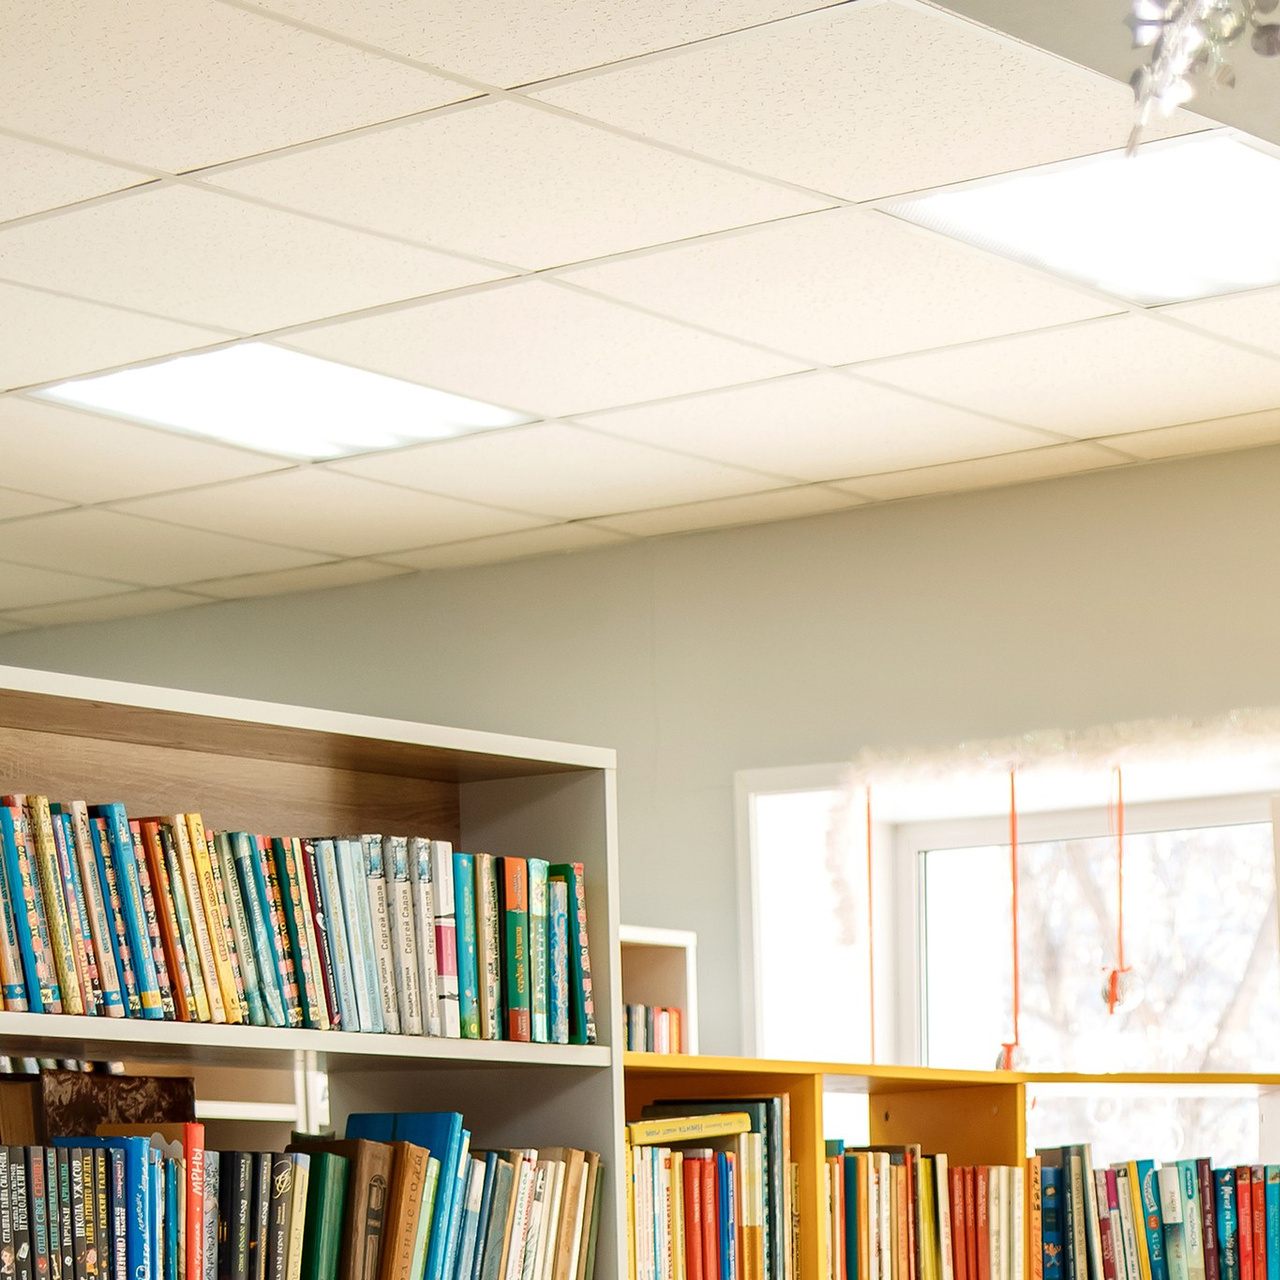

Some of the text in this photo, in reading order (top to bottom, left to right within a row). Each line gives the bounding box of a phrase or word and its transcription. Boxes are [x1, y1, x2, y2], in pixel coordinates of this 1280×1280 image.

[376, 885, 385, 914] Садов
[402, 889, 410, 918] Садов
[380, 917, 389, 950] Сергей
[404, 921, 413, 954] Сергей
[73, 1160, 85, 1237] ШКОЛА УЖАСОВ
